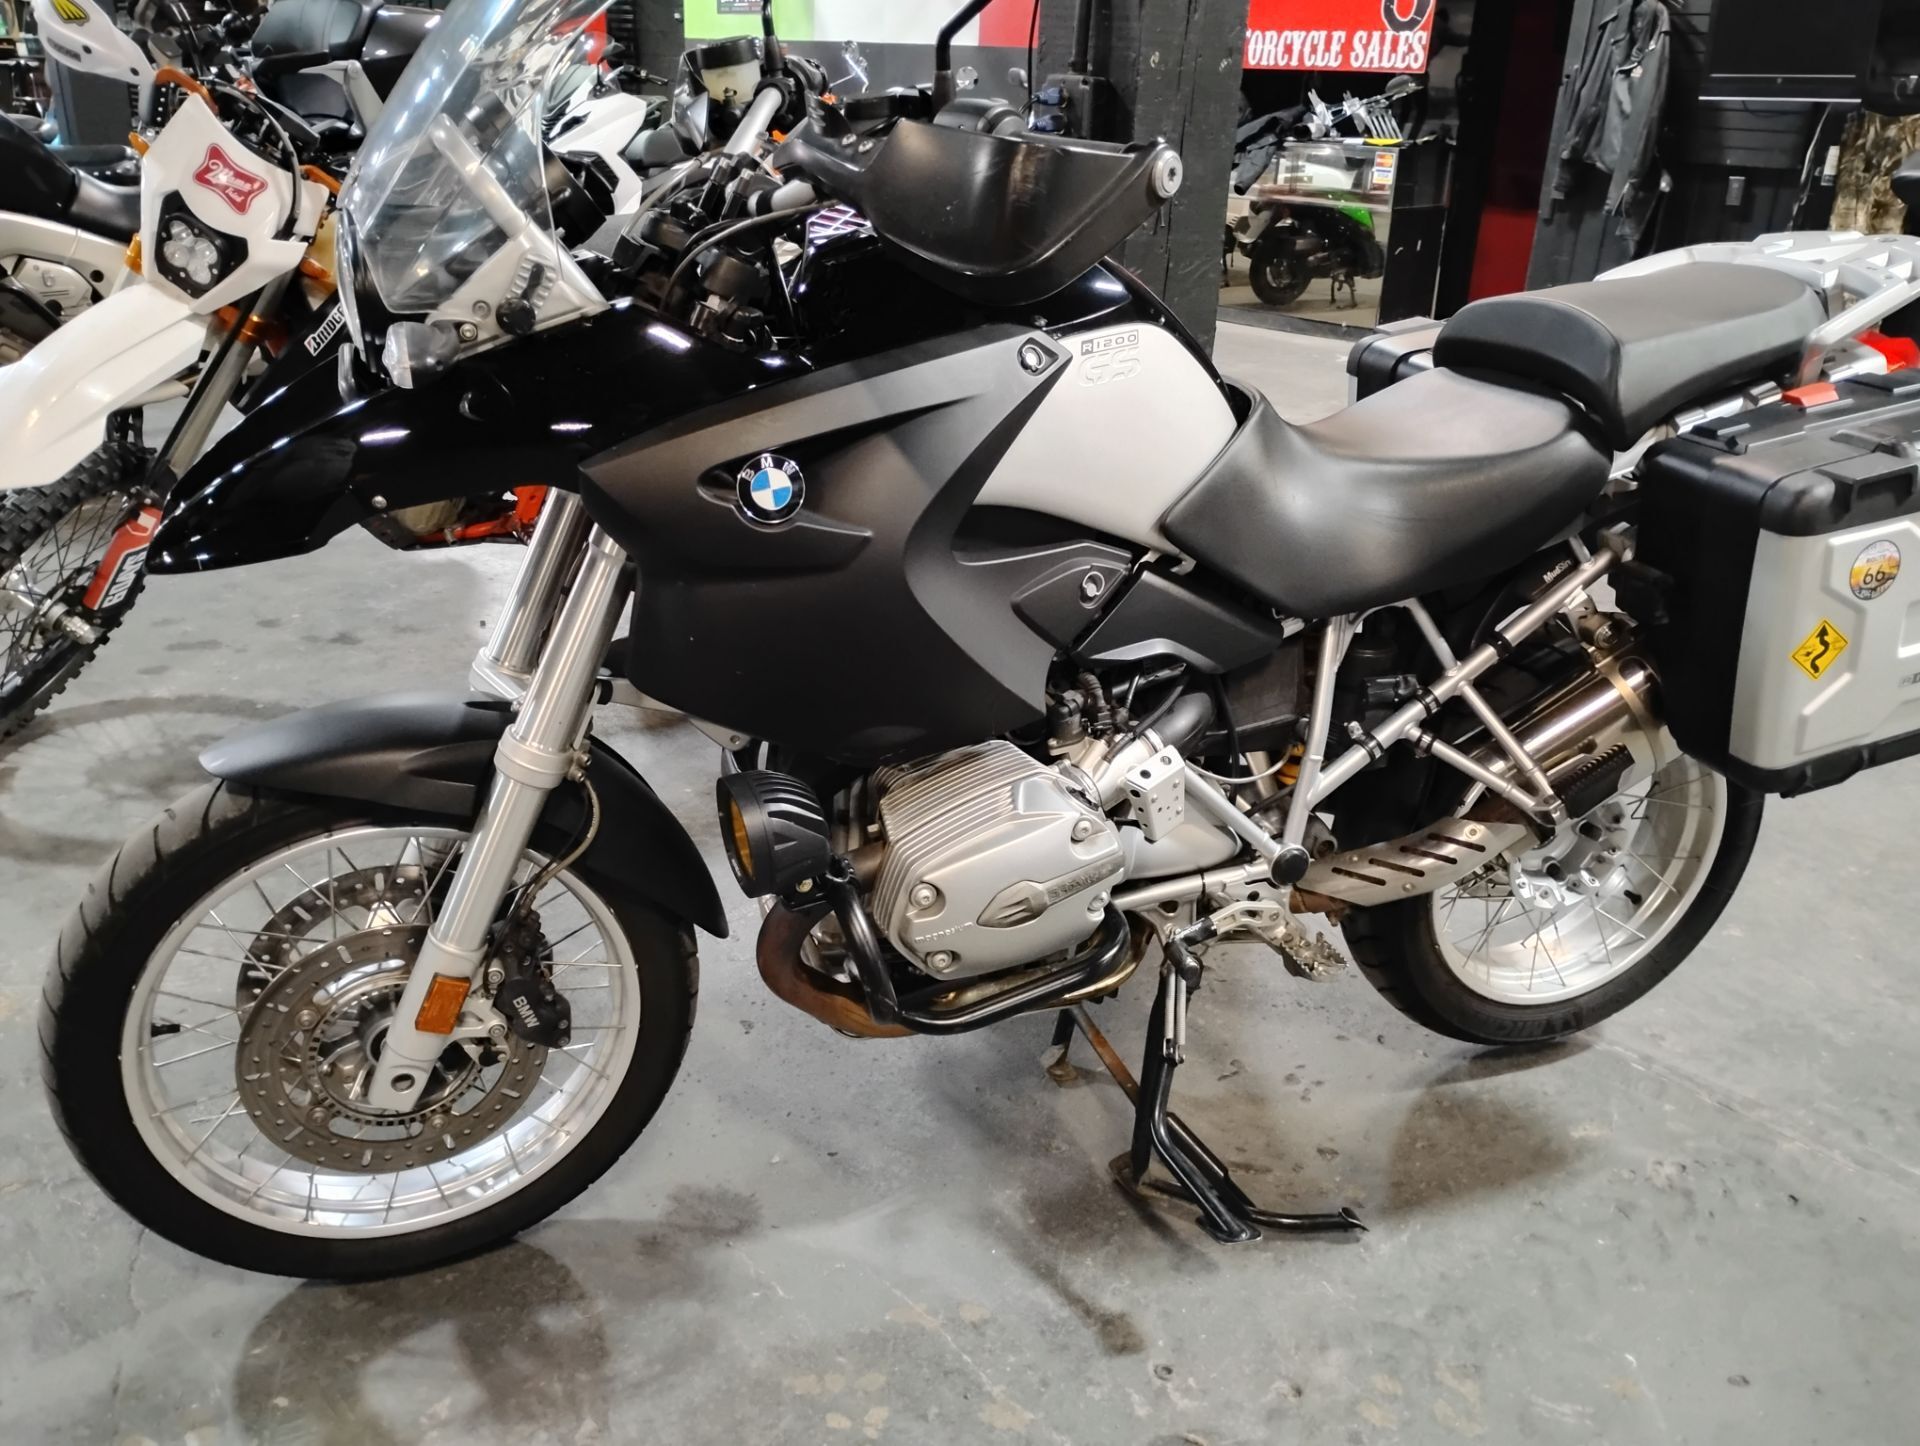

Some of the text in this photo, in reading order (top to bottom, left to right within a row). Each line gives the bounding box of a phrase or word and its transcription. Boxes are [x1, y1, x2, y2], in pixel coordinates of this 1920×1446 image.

[1246, 29, 1427, 69] ORCYCLE SALES
[1081, 333, 1137, 355] R1200
[741, 456, 796, 482] BMW
[1863, 564, 1886, 585] 66
[512, 995, 540, 1028] BMW
